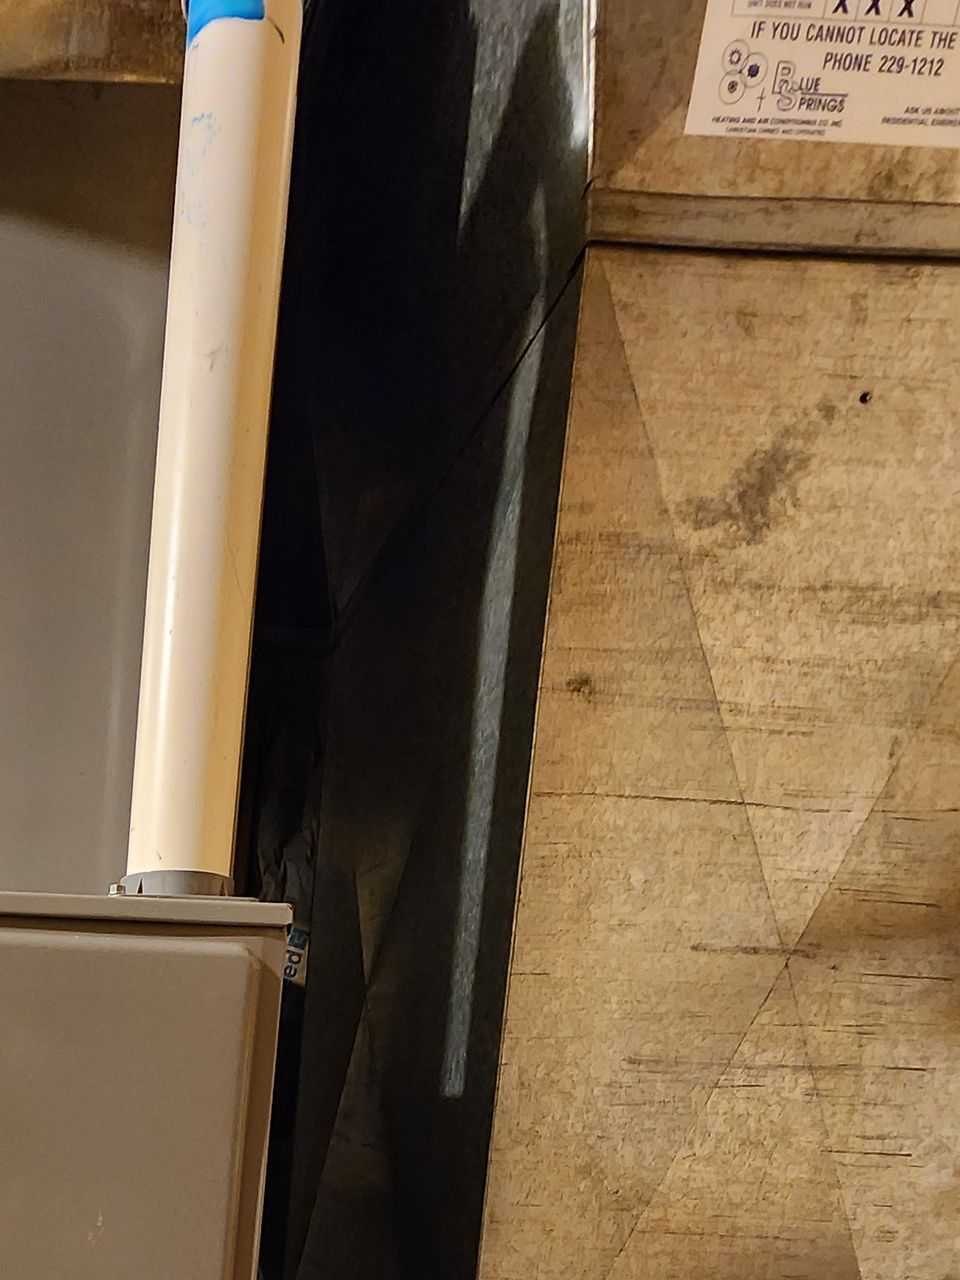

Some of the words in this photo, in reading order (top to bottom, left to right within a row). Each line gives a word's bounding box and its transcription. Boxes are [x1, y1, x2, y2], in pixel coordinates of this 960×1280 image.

[750, 20, 766, 39] IF
[771, 21, 801, 41] YOU
[805, 23, 866, 45] CANNOT
[869, 27, 925, 48] LOCATE
[930, 31, 958, 50] THE
[822, 52, 873, 72] PHONE
[878, 55, 945, 76] 229-1212
